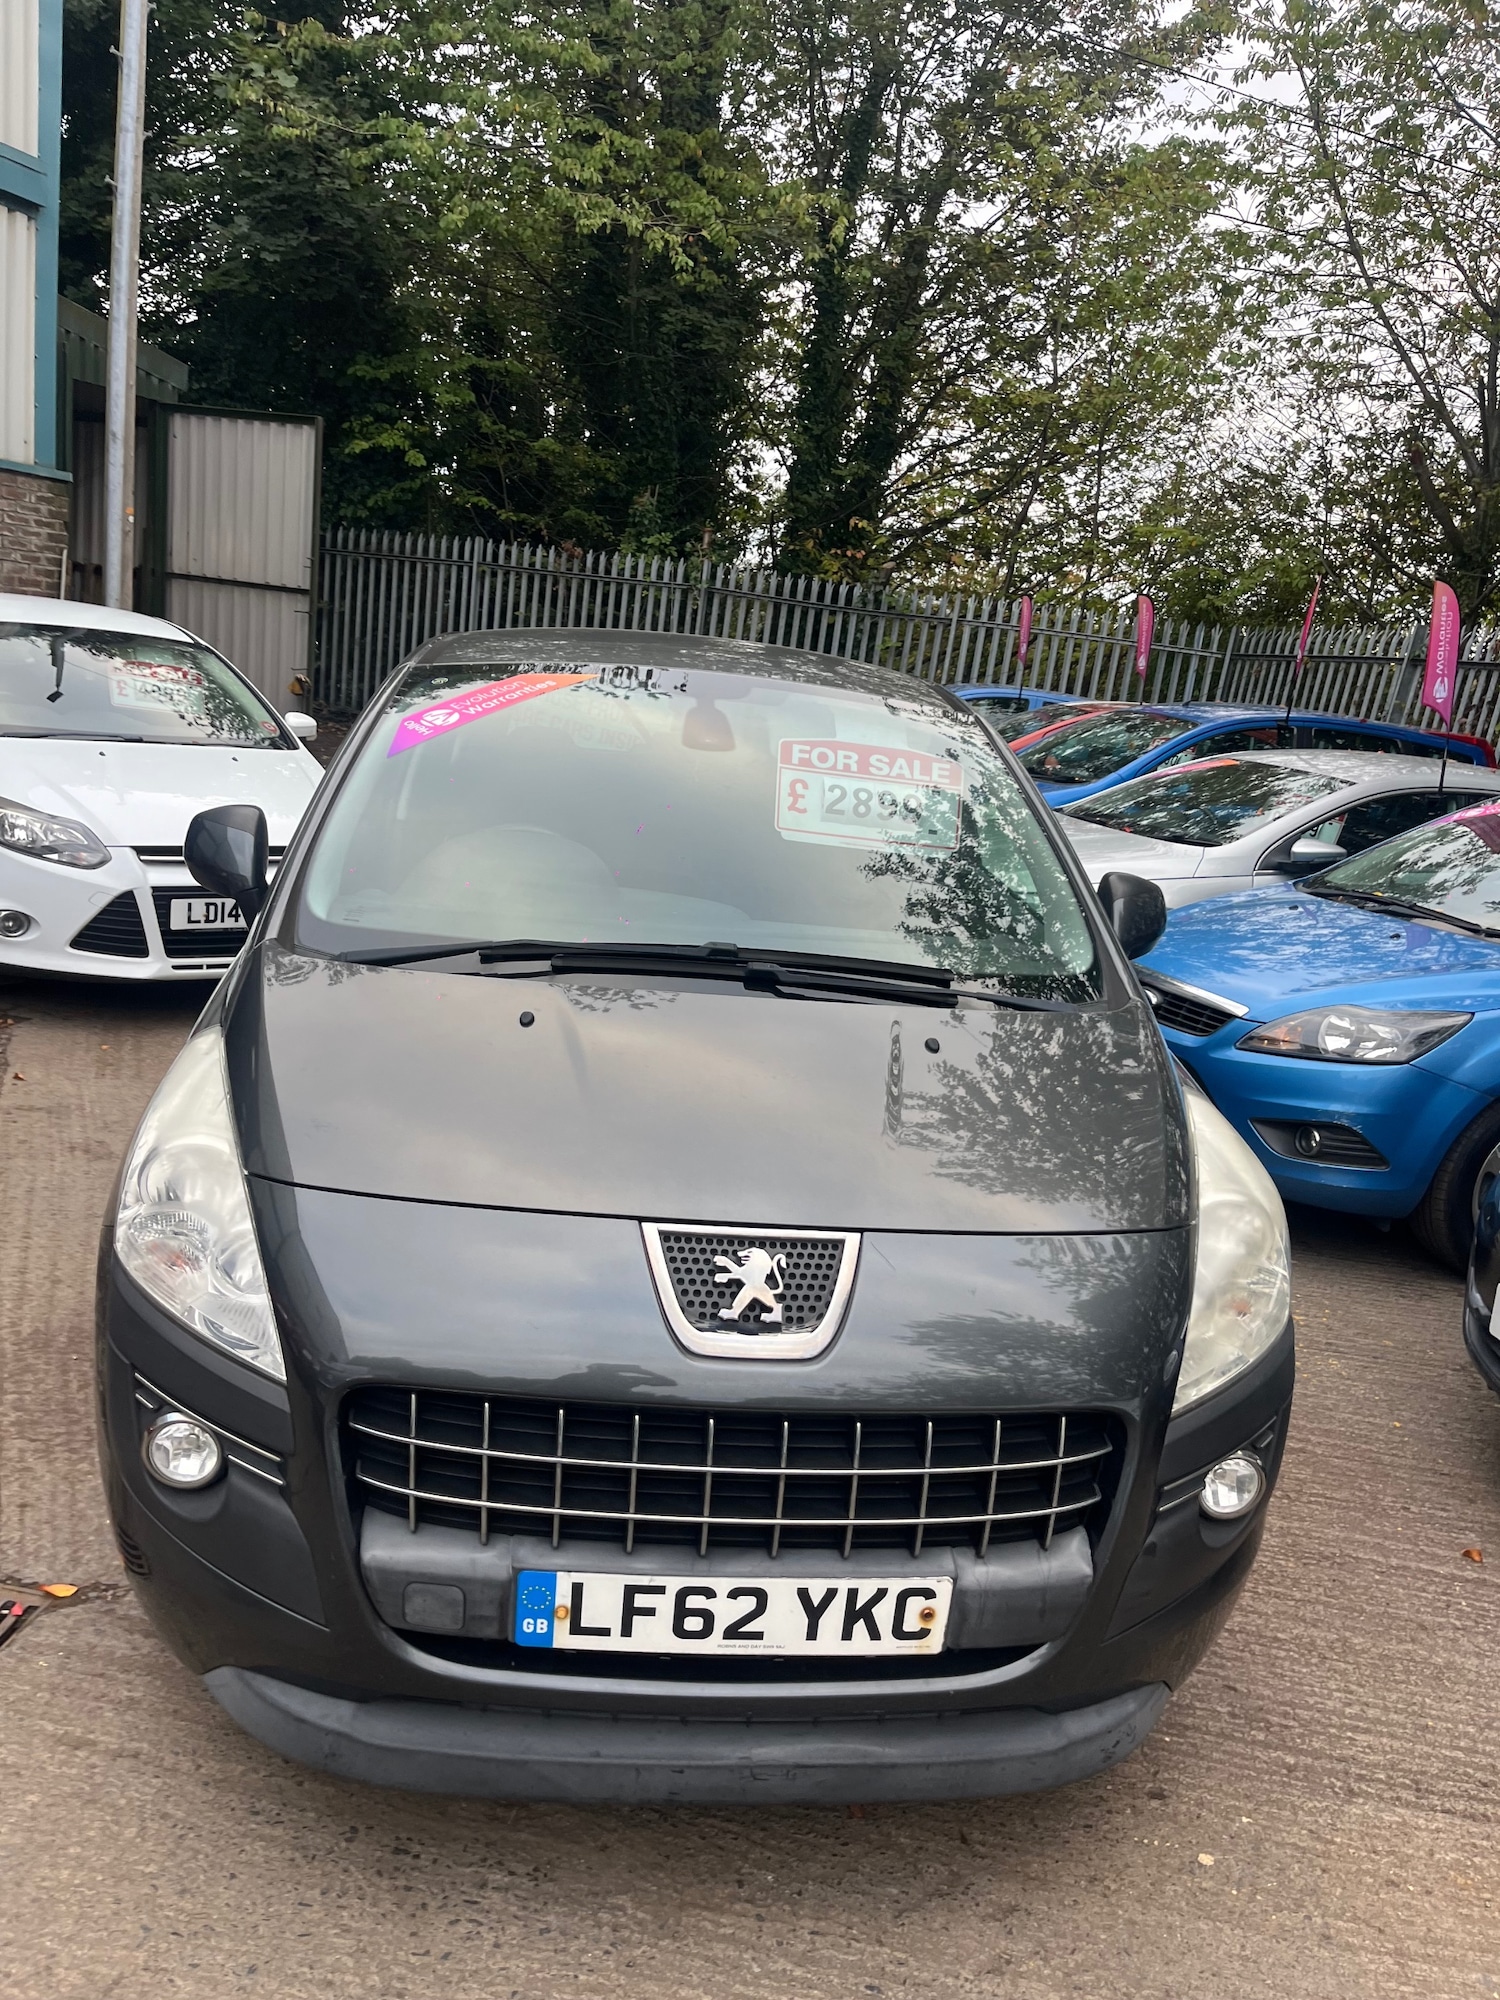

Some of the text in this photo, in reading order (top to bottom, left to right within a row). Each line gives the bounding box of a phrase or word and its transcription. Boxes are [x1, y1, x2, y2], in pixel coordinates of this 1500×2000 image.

[449, 679, 527, 711] Evolution
[461, 678, 557, 715] Warranties
[403, 720, 434, 736] Hello
[791, 743, 950, 783] FOR SALE
[787, 778, 809, 814] £
[187, 901, 241, 924] LD14
[522, 1582, 938, 1642] GB LF62 YKC
